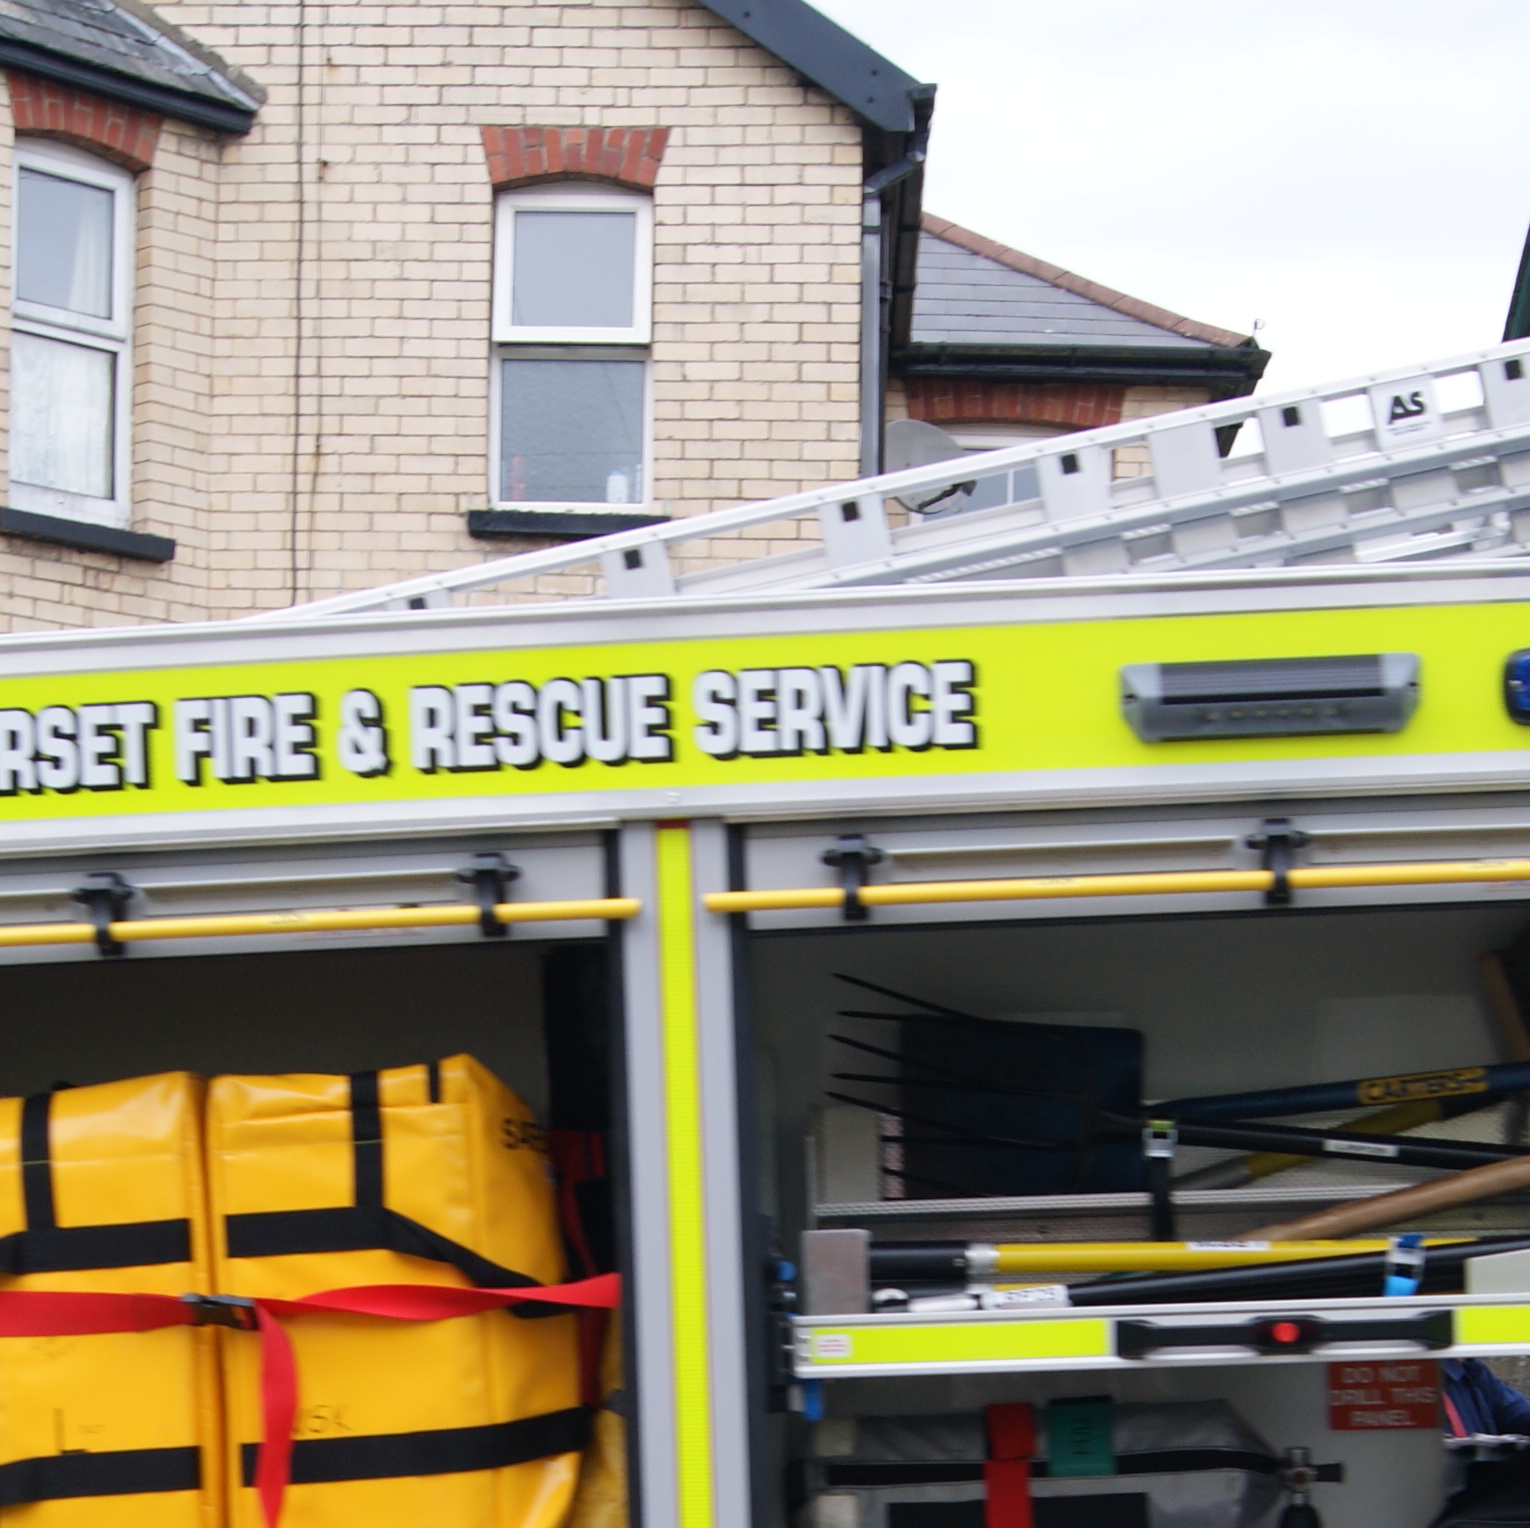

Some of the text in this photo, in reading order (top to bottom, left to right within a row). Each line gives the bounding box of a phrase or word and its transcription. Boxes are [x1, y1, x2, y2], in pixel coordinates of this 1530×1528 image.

[172, 691, 321, 787] FIRE
[338, 688, 391, 777] &
[409, 673, 675, 776] RESCUE
[693, 659, 980, 760] SERVICE
[1341, 1365, 1422, 1383] DO NOT
[1329, 1387, 1438, 1406] DRILL THIS
[1350, 1410, 1417, 1427] PANEL
